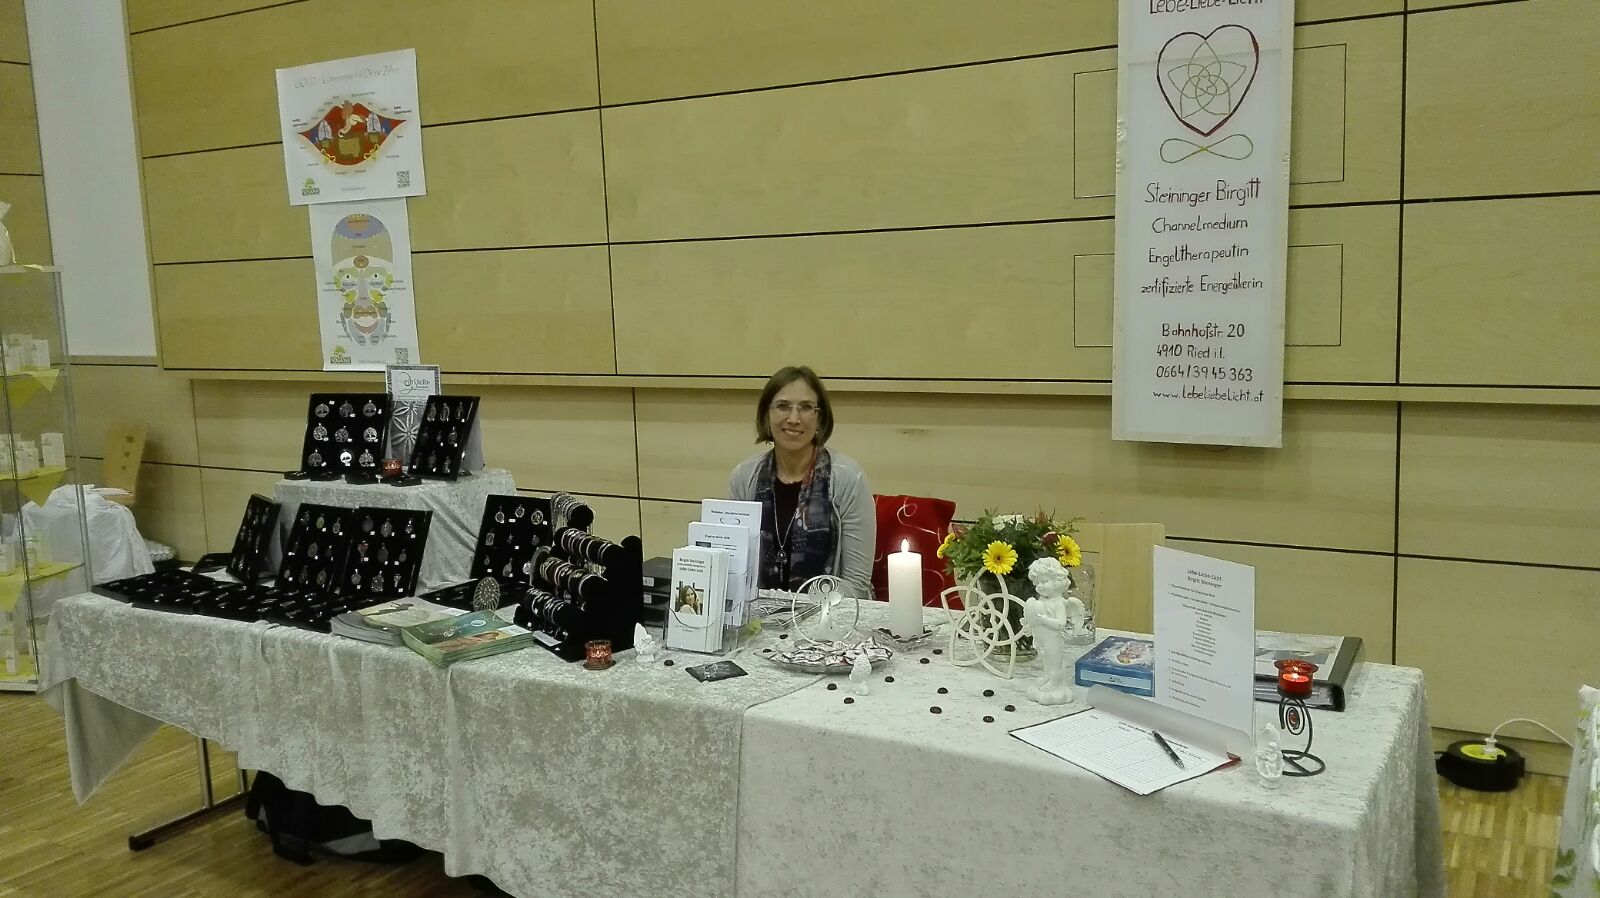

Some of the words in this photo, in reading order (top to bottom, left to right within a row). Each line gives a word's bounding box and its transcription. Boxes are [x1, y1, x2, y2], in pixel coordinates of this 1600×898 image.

[1145, 182, 1212, 207] Steininger
[1216, 177, 1261, 206] Birgitt
[1152, 213, 1248, 233] Channelmedium
[1149, 244, 1249, 267] Engeltherapeutin
[1141, 276, 1194, 297] zertifizierte
[1200, 272, 1263, 294] Energetikerin
[1227, 323, 1245, 338] 20
[1156, 344, 1183, 357] 4910
[1187, 345, 1210, 359] Ried
[1212, 367, 1226, 380] 45
[1229, 368, 1253, 382] 363
